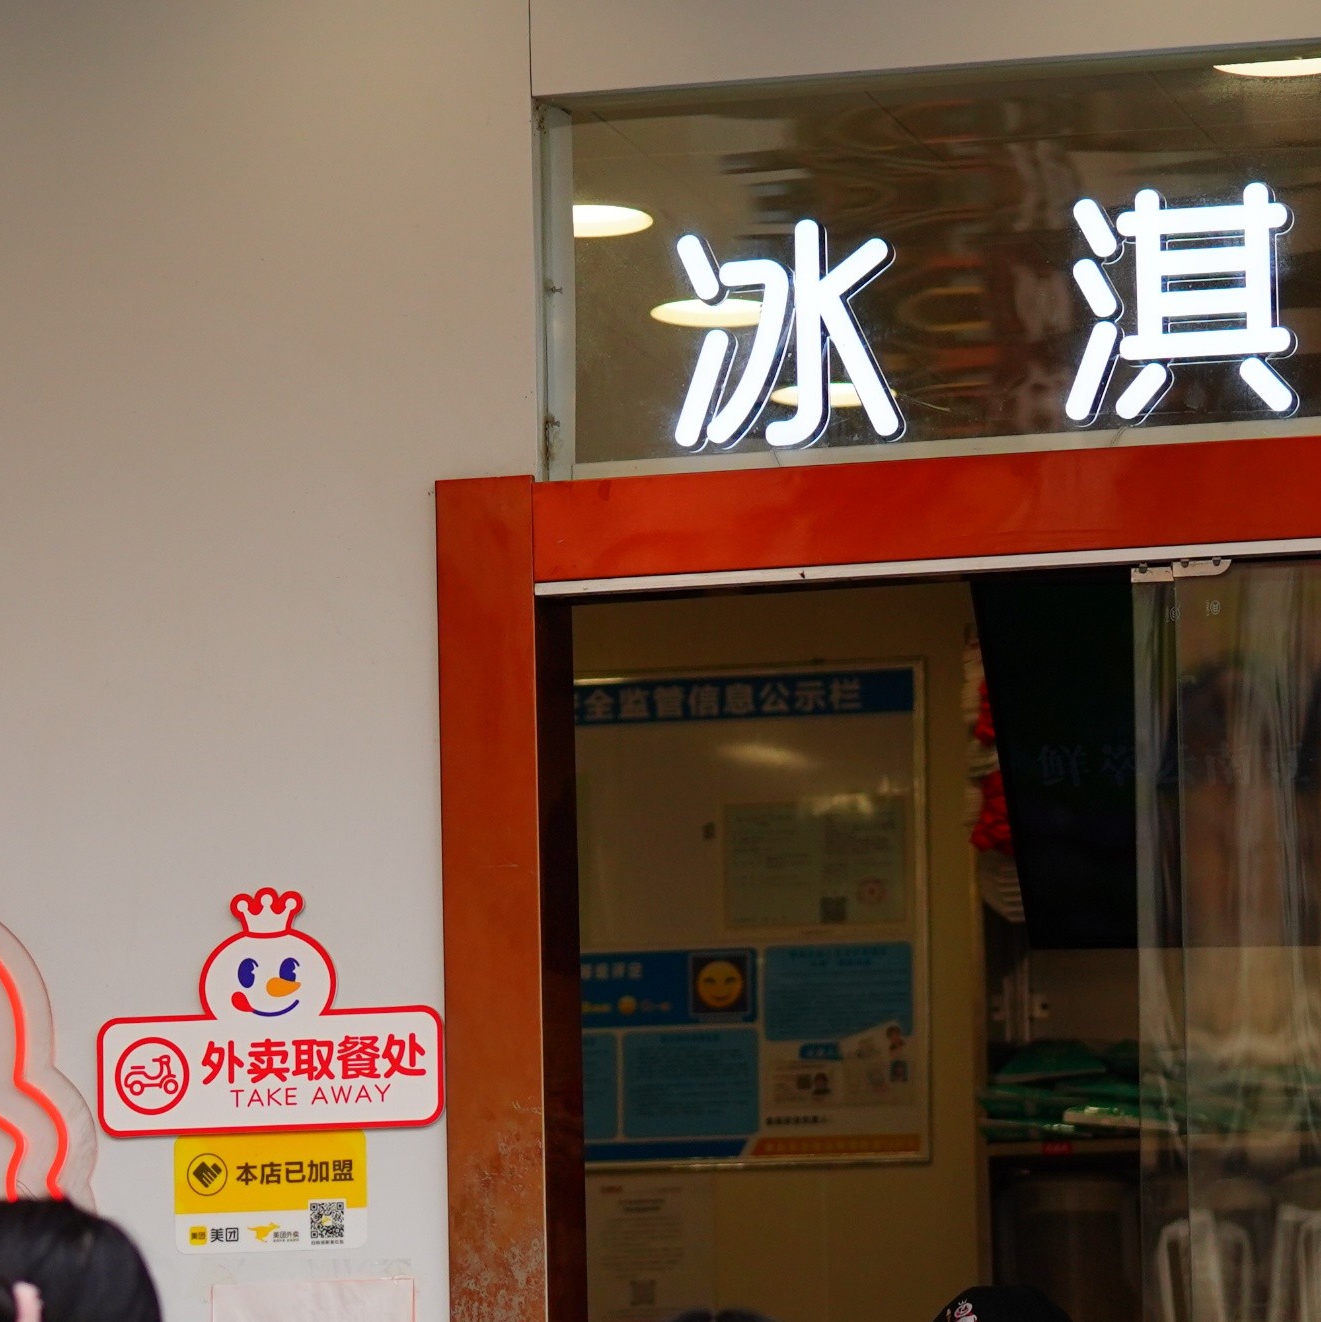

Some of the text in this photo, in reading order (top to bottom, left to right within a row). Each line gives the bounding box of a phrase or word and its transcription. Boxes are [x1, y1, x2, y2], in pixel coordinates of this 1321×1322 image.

[575, 677, 863, 724] 全监管信息公示栏
[201, 1032, 427, 1086] 外卖取餐处
[230, 1083, 392, 1108] TAKE AWAY
[235, 1159, 355, 1186] 本店已加盟
[210, 1227, 239, 1243] 美团
